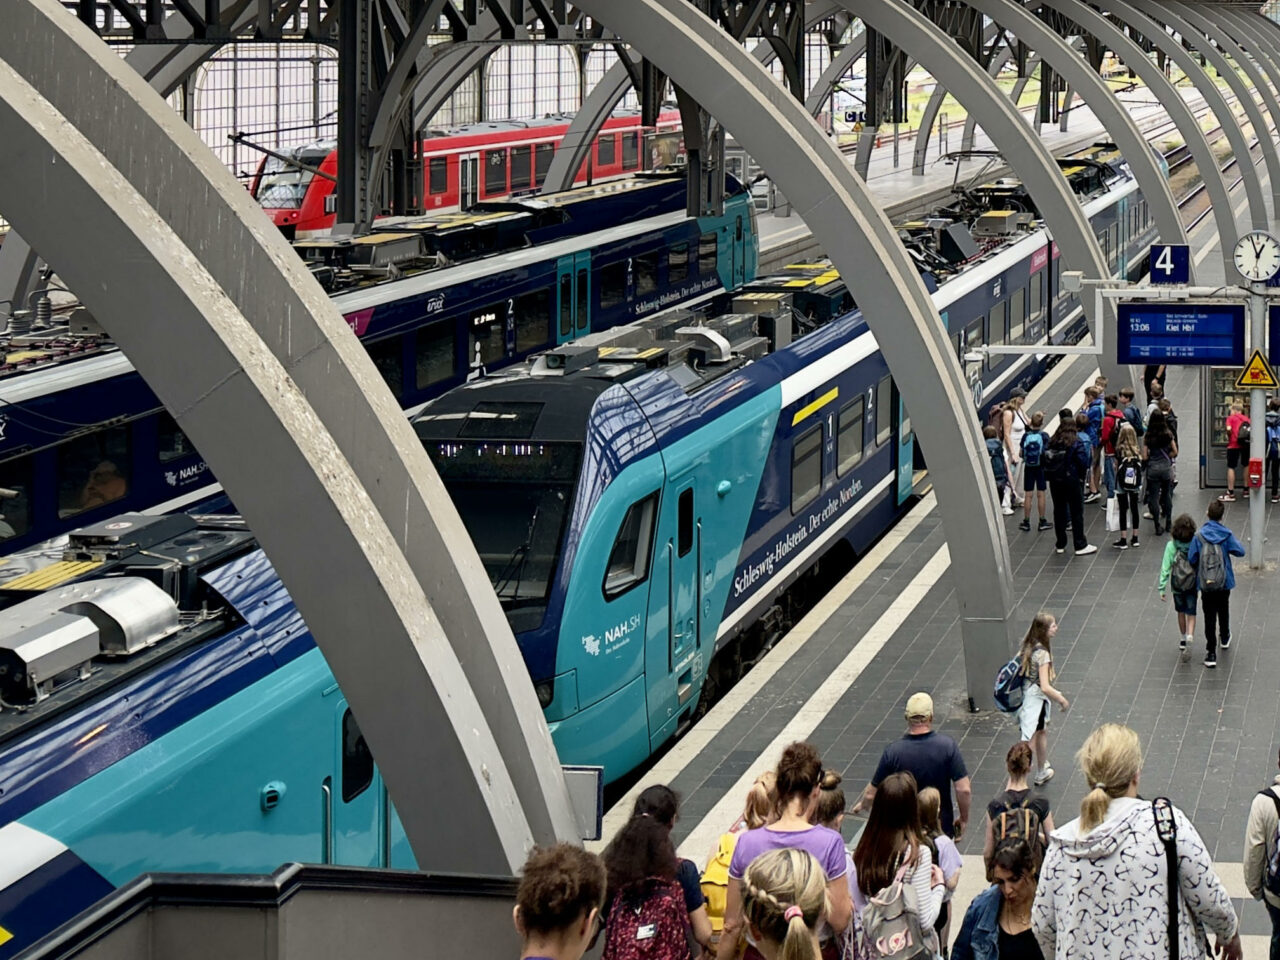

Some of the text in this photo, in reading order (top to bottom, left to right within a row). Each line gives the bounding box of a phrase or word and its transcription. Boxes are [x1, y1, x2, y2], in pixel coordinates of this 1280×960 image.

[1155, 246, 1175, 275] 4
[507, 298, 514, 315] 2
[1166, 324, 1180, 332] Kiel
[867, 387, 873, 409] 2
[827, 414, 833, 438] 1
[734, 479, 864, 598] Schleswig-Holstein. Der echte Norden.
[605, 612, 641, 645] NAH.SH
